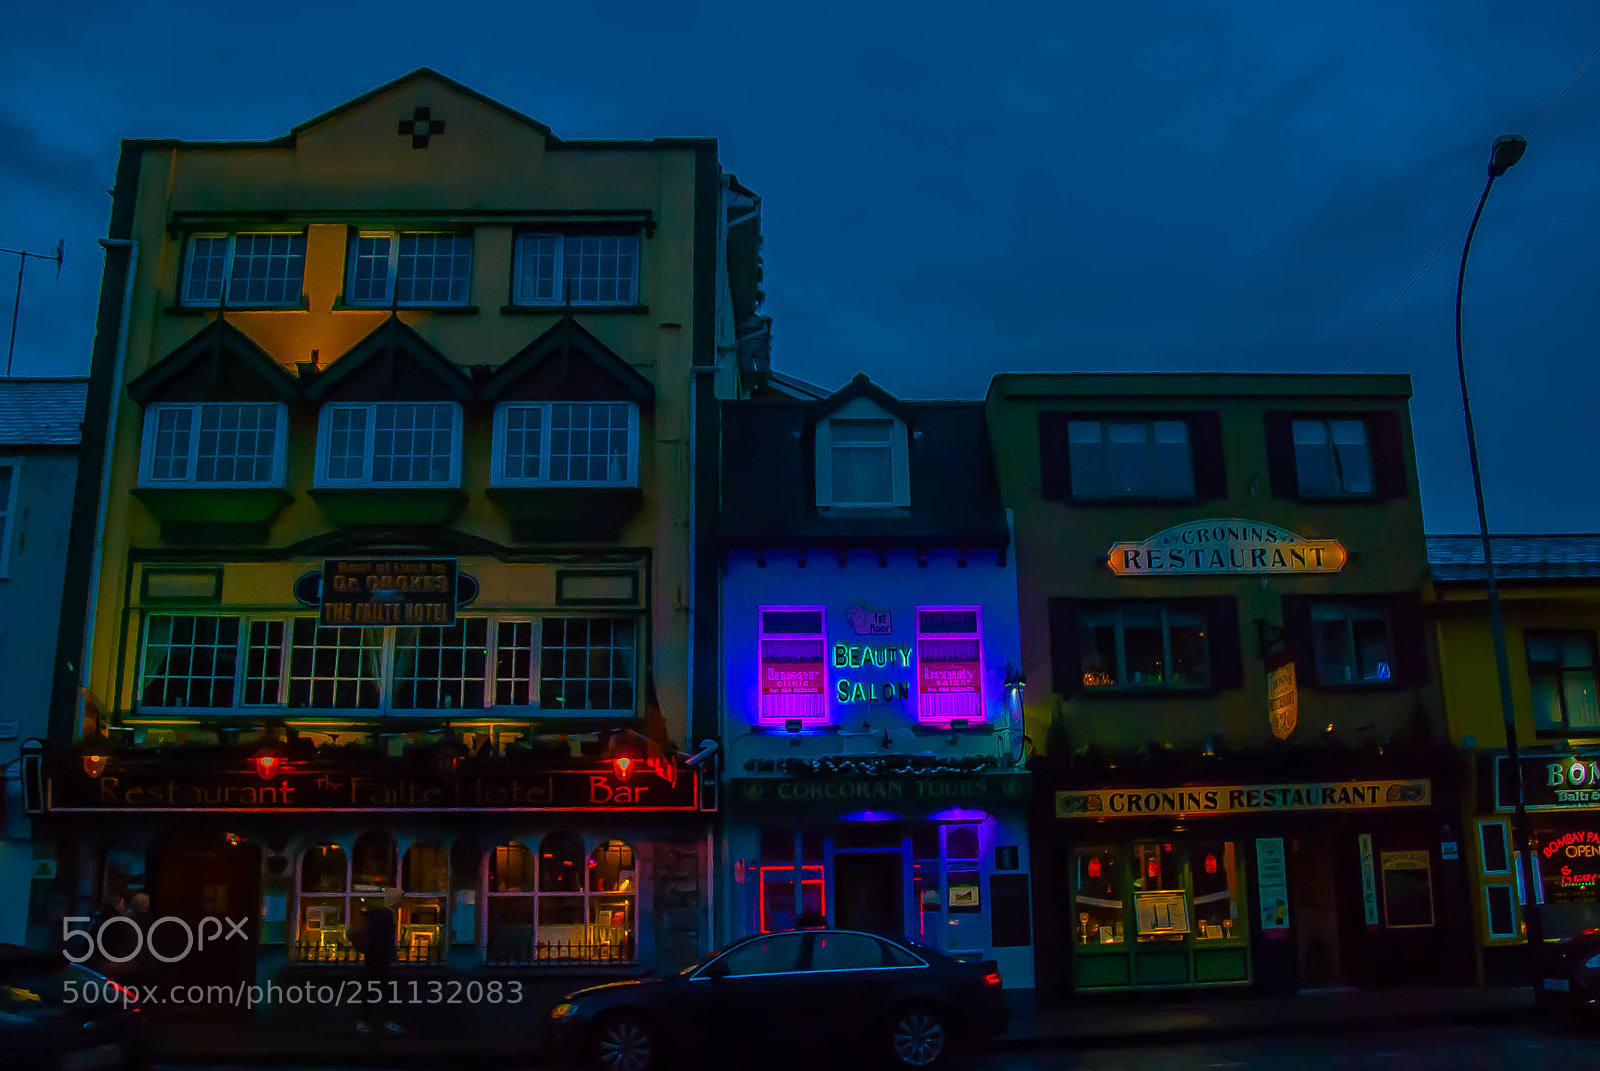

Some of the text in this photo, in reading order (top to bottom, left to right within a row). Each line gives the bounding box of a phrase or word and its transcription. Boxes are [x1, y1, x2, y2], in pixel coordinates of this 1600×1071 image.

[1182, 526, 1279, 545] CRONINS
[1123, 547, 1327, 570] RESTAURANT
[325, 602, 352, 623] THE
[405, 602, 449, 623] HOTEL
[874, 613, 887, 624] 1st
[870, 624, 890, 634] floor
[834, 643, 913, 668] BEAUTY
[924, 667, 976, 680] beauty
[837, 678, 910, 703] SALON
[100, 776, 296, 805] Restaurant
[589, 774, 650, 805] Bar
[777, 778, 988, 800] CORCORAN TOURS
[1109, 785, 1381, 813] CRONINS RESTAURANT
[1558, 791, 1589, 802] Balti
[1542, 831, 1600, 858] BOMBAY PA
[1565, 845, 1600, 858] OPEN
